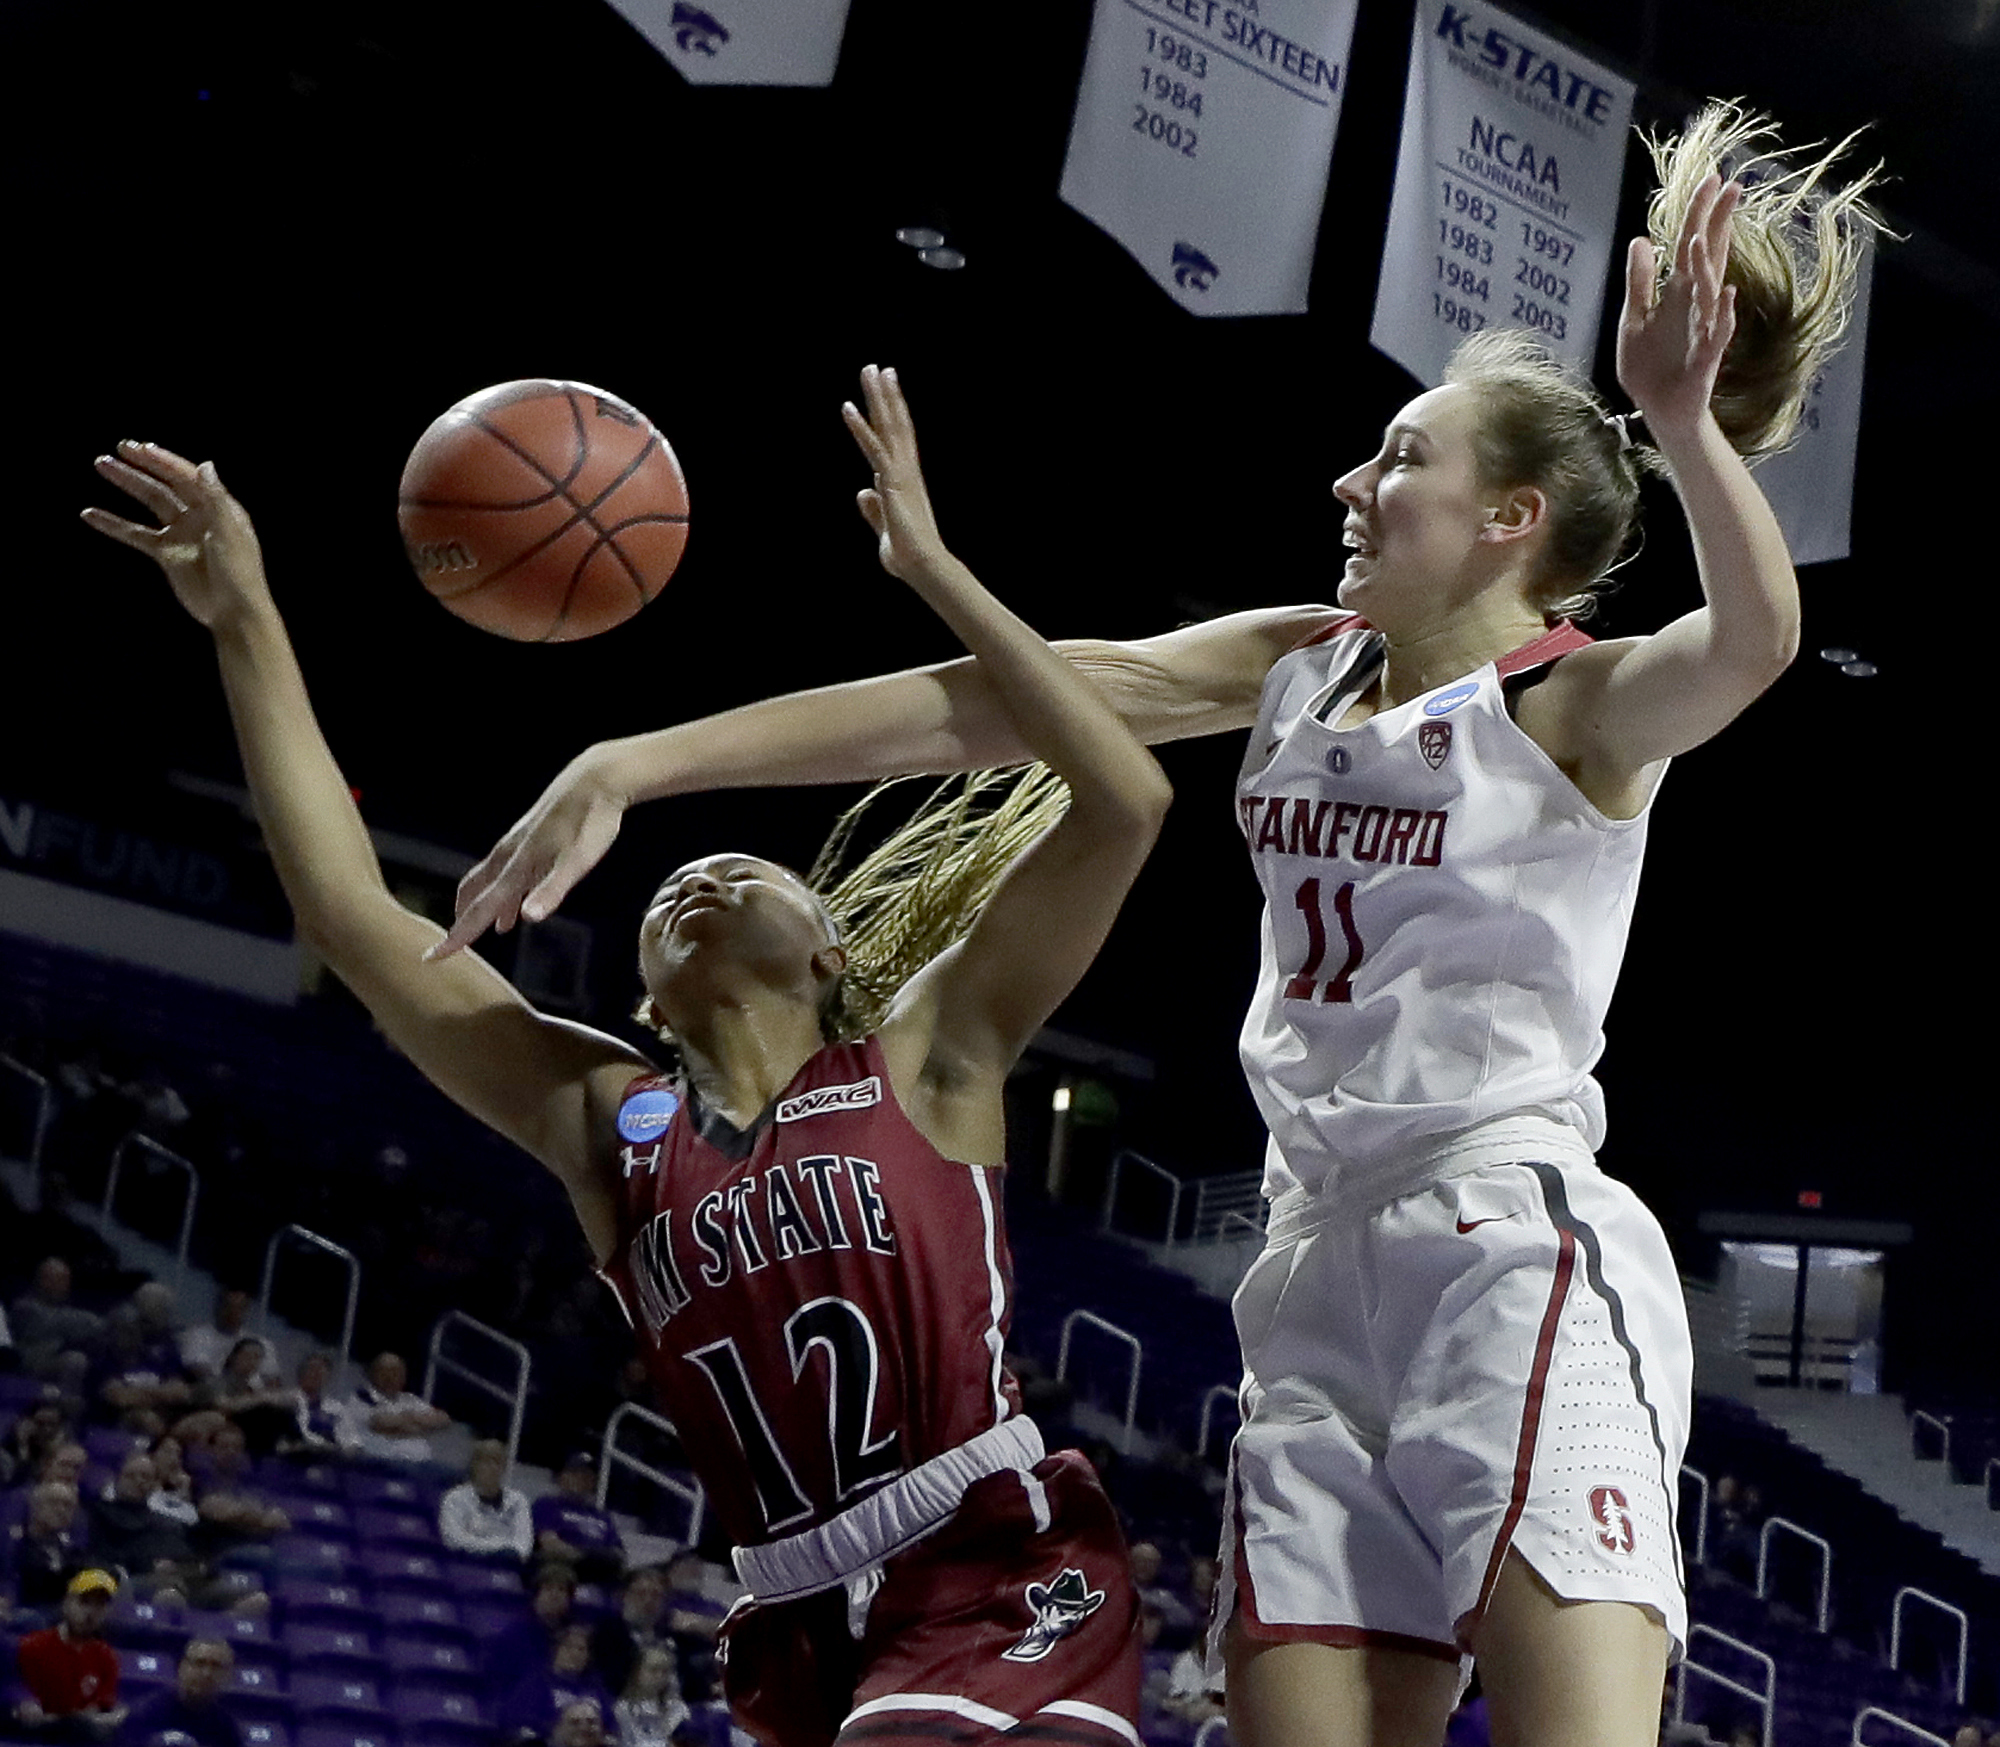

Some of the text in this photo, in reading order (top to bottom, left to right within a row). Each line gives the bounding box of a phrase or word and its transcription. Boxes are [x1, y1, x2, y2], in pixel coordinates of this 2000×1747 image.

[1141, 66, 1202, 118] 1984
[1147, 27, 1207, 79] 1983
[1221, 9, 1340, 94] SIXTEEN
[1437, 2, 1613, 126] K-STATE
[1133, 103, 1198, 158] 2002
[1470, 115, 1560, 193] NCAA
[1442, 181, 1575, 267] 1982 1997
[1457, 147, 1569, 220] TOURNAMENT
[1436, 255, 1568, 340] 1984 2003
[1438, 218, 1571, 306] 1983 2002
[1284, 877, 1364, 1003] 11
[780, 1080, 877, 1119] WAC
[691, 1154, 897, 1288] STATE
[681, 1295, 904, 1534] 12
